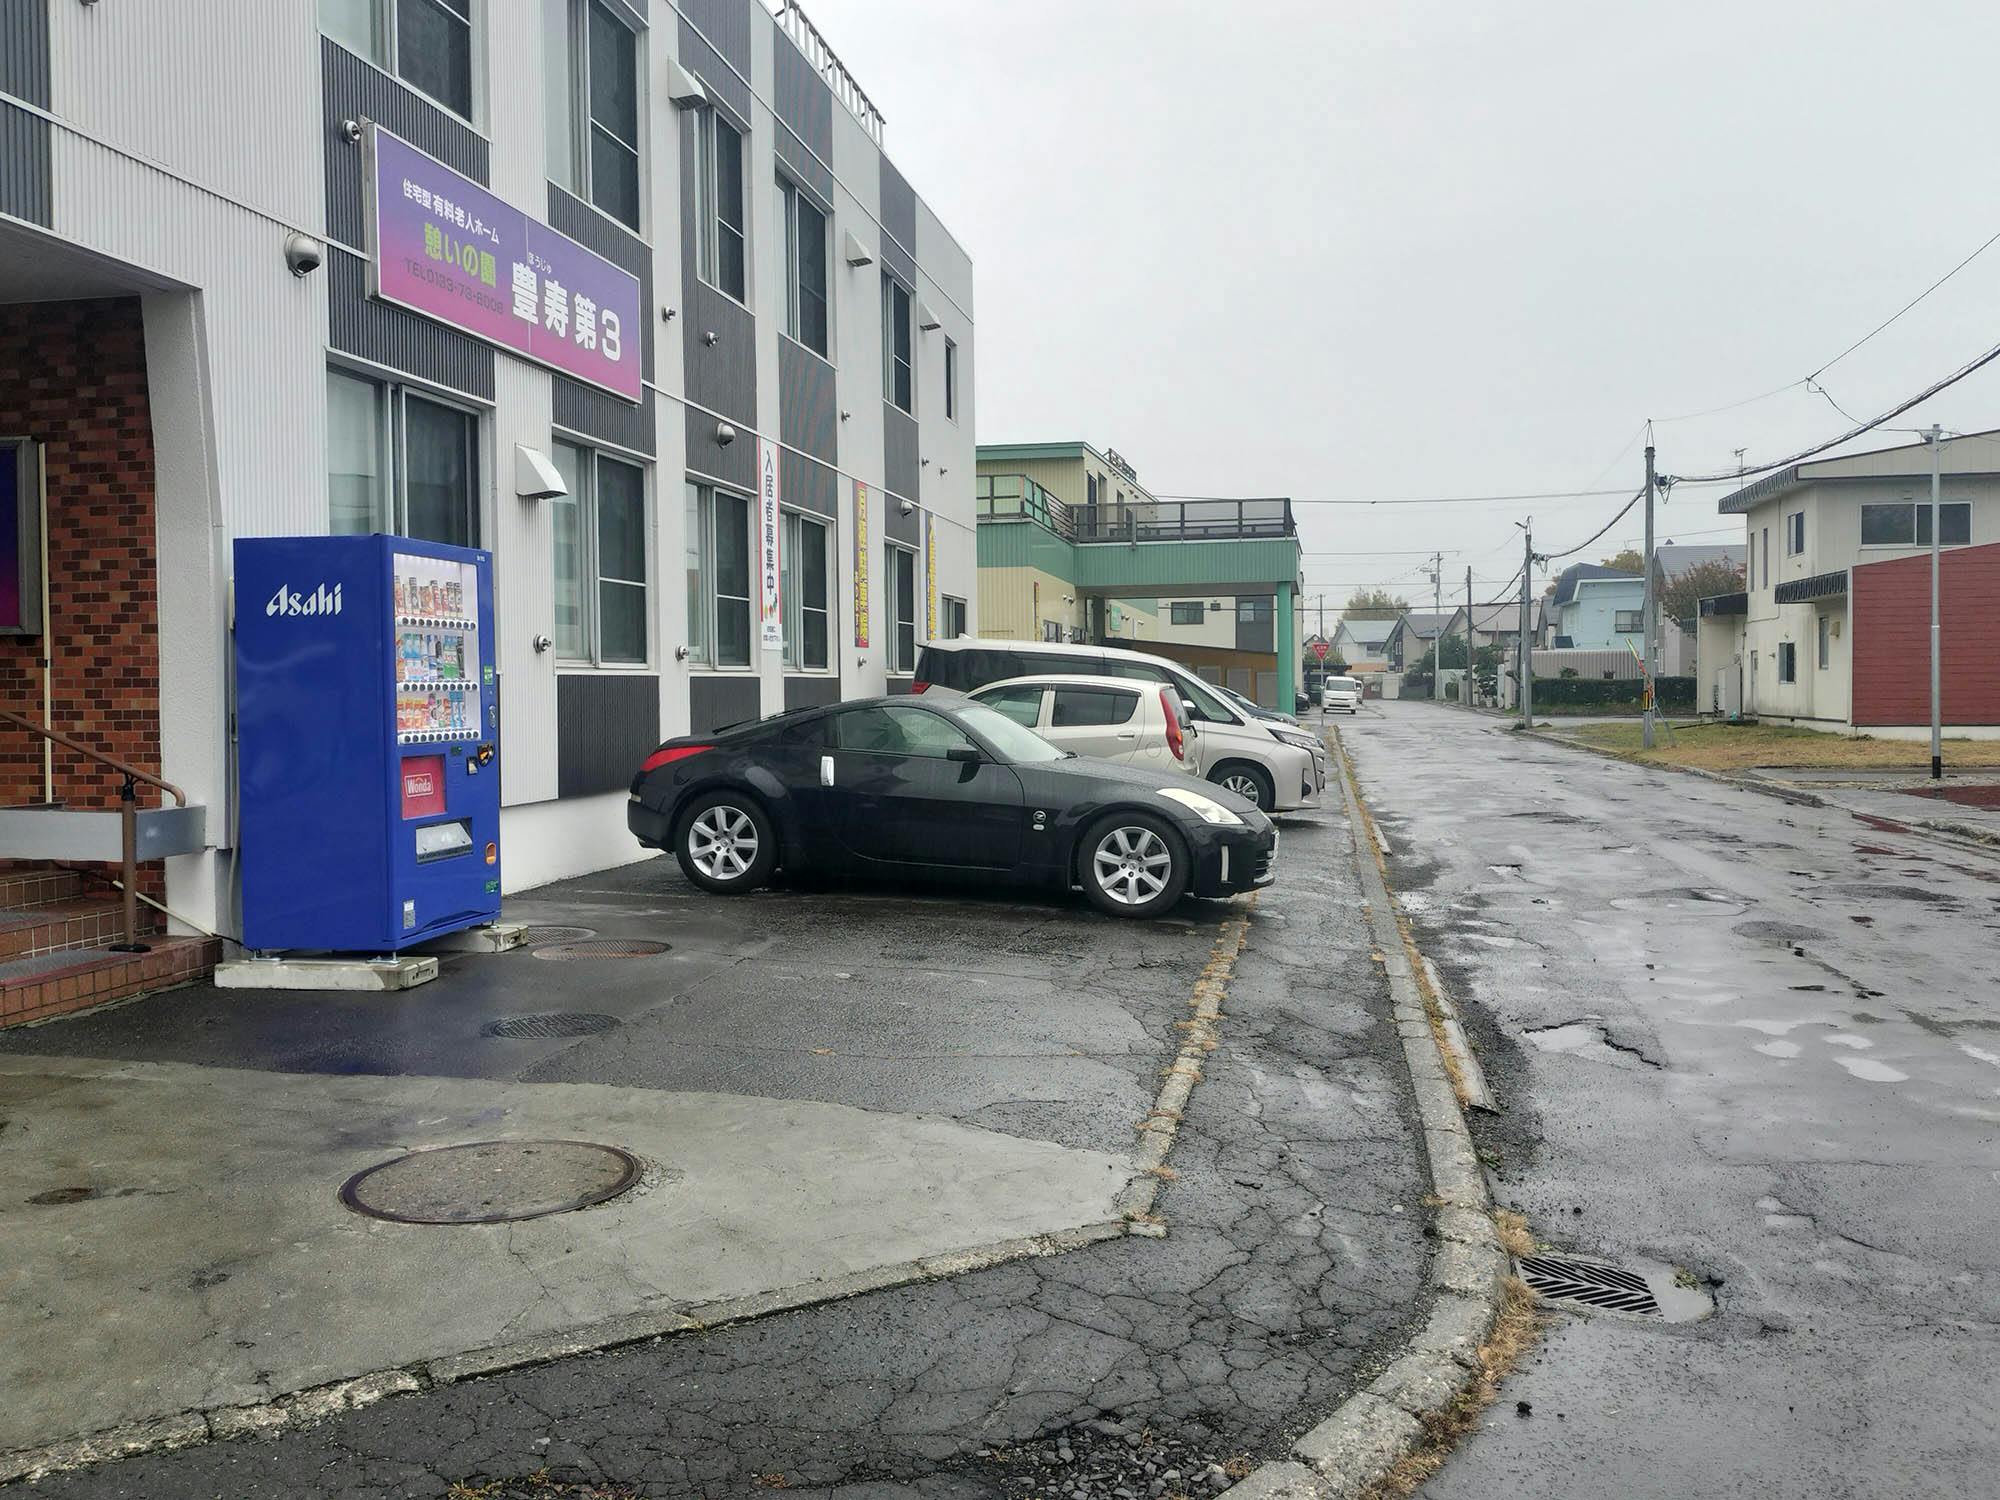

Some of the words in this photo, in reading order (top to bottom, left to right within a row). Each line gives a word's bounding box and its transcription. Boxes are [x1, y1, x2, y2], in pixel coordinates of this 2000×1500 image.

[403, 178, 432, 210] 住宅型
[433, 194, 500, 245] 有料老人ホーム
[425, 223, 496, 288] 憩いの園
[528, 252, 553, 274] ほうじゅ
[512, 262, 621, 361] 豊寿第3
[765, 450, 775, 595] 入居者募集中
[266, 582, 342, 617] Asahi
[407, 778, 432, 794] Wonda
